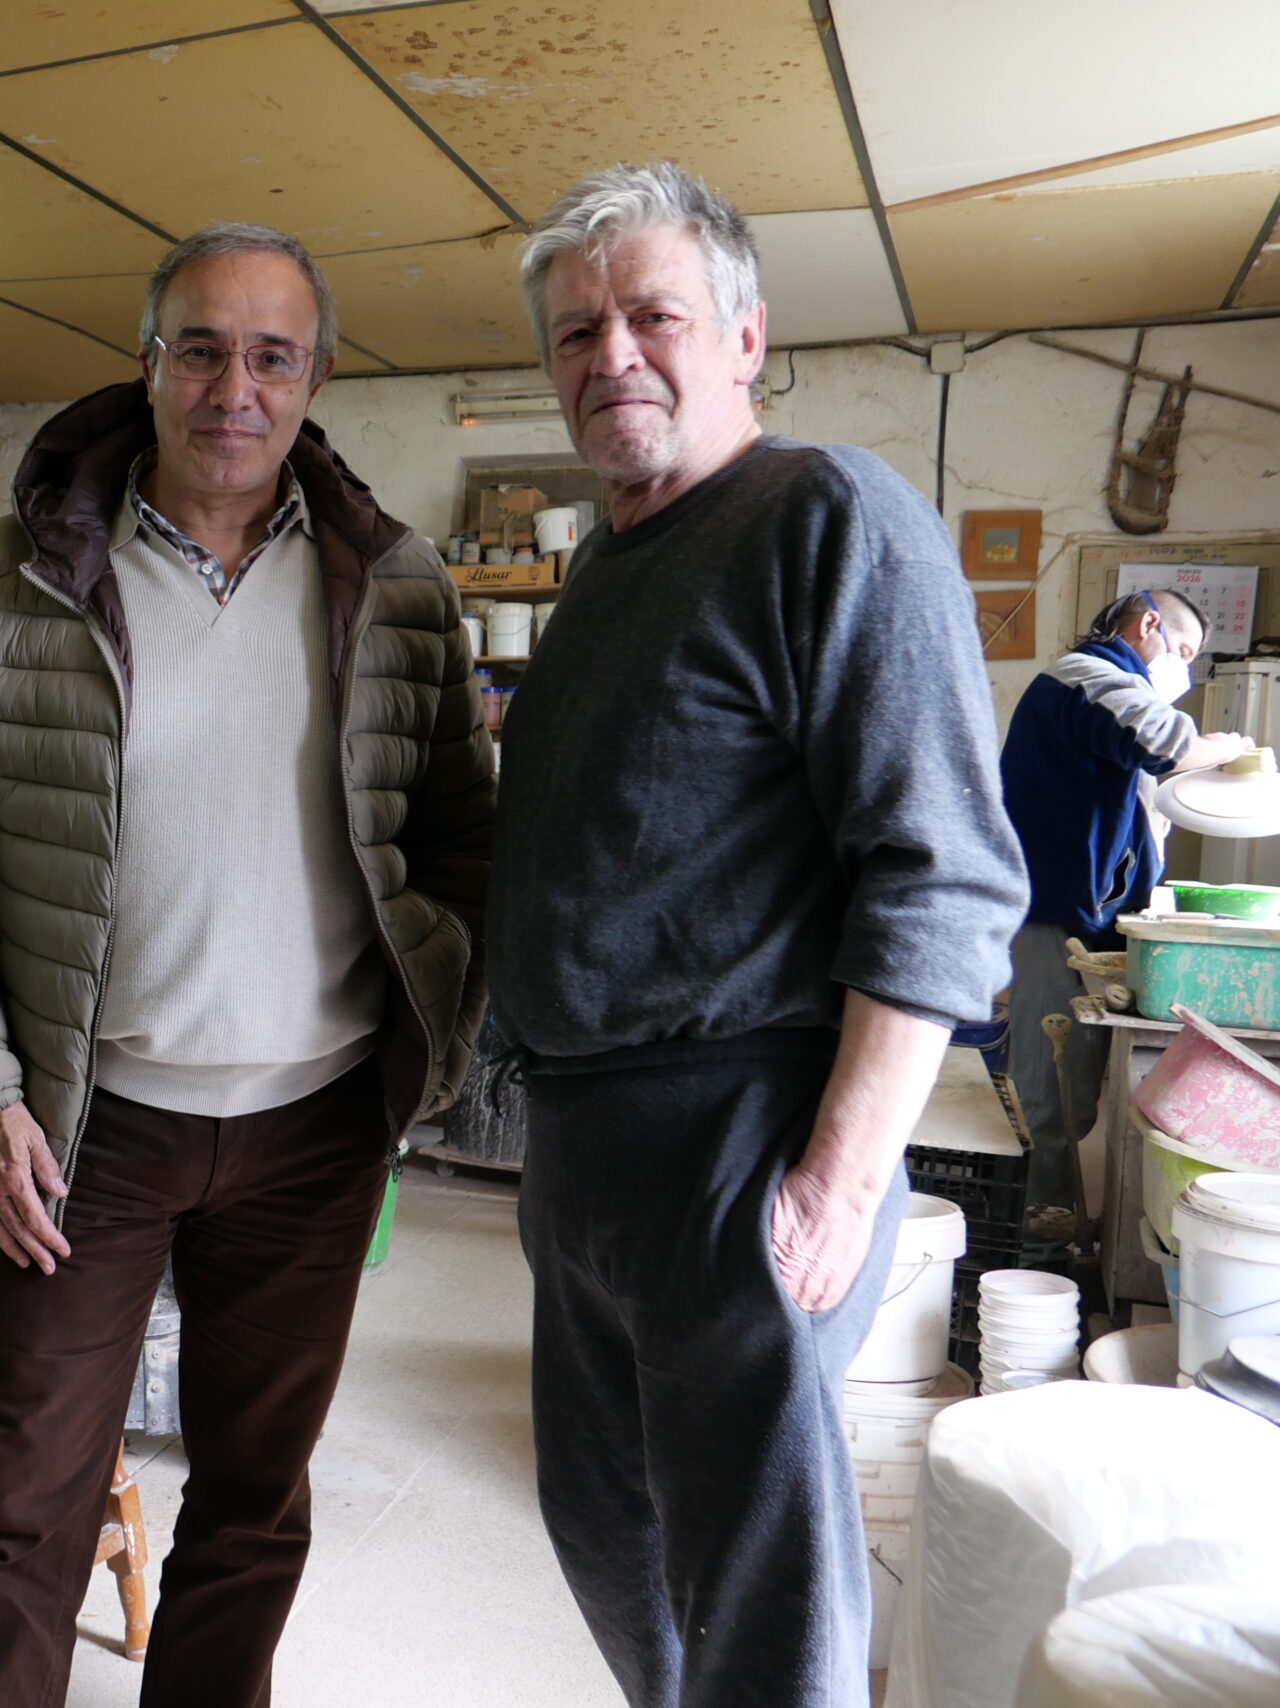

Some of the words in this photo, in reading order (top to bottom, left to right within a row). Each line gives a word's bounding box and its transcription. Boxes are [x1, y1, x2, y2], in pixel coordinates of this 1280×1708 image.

[465, 566, 512, 582] Llusar
[1176, 568, 1202, 576] marzo
[1176, 575, 1201, 583] 2026
